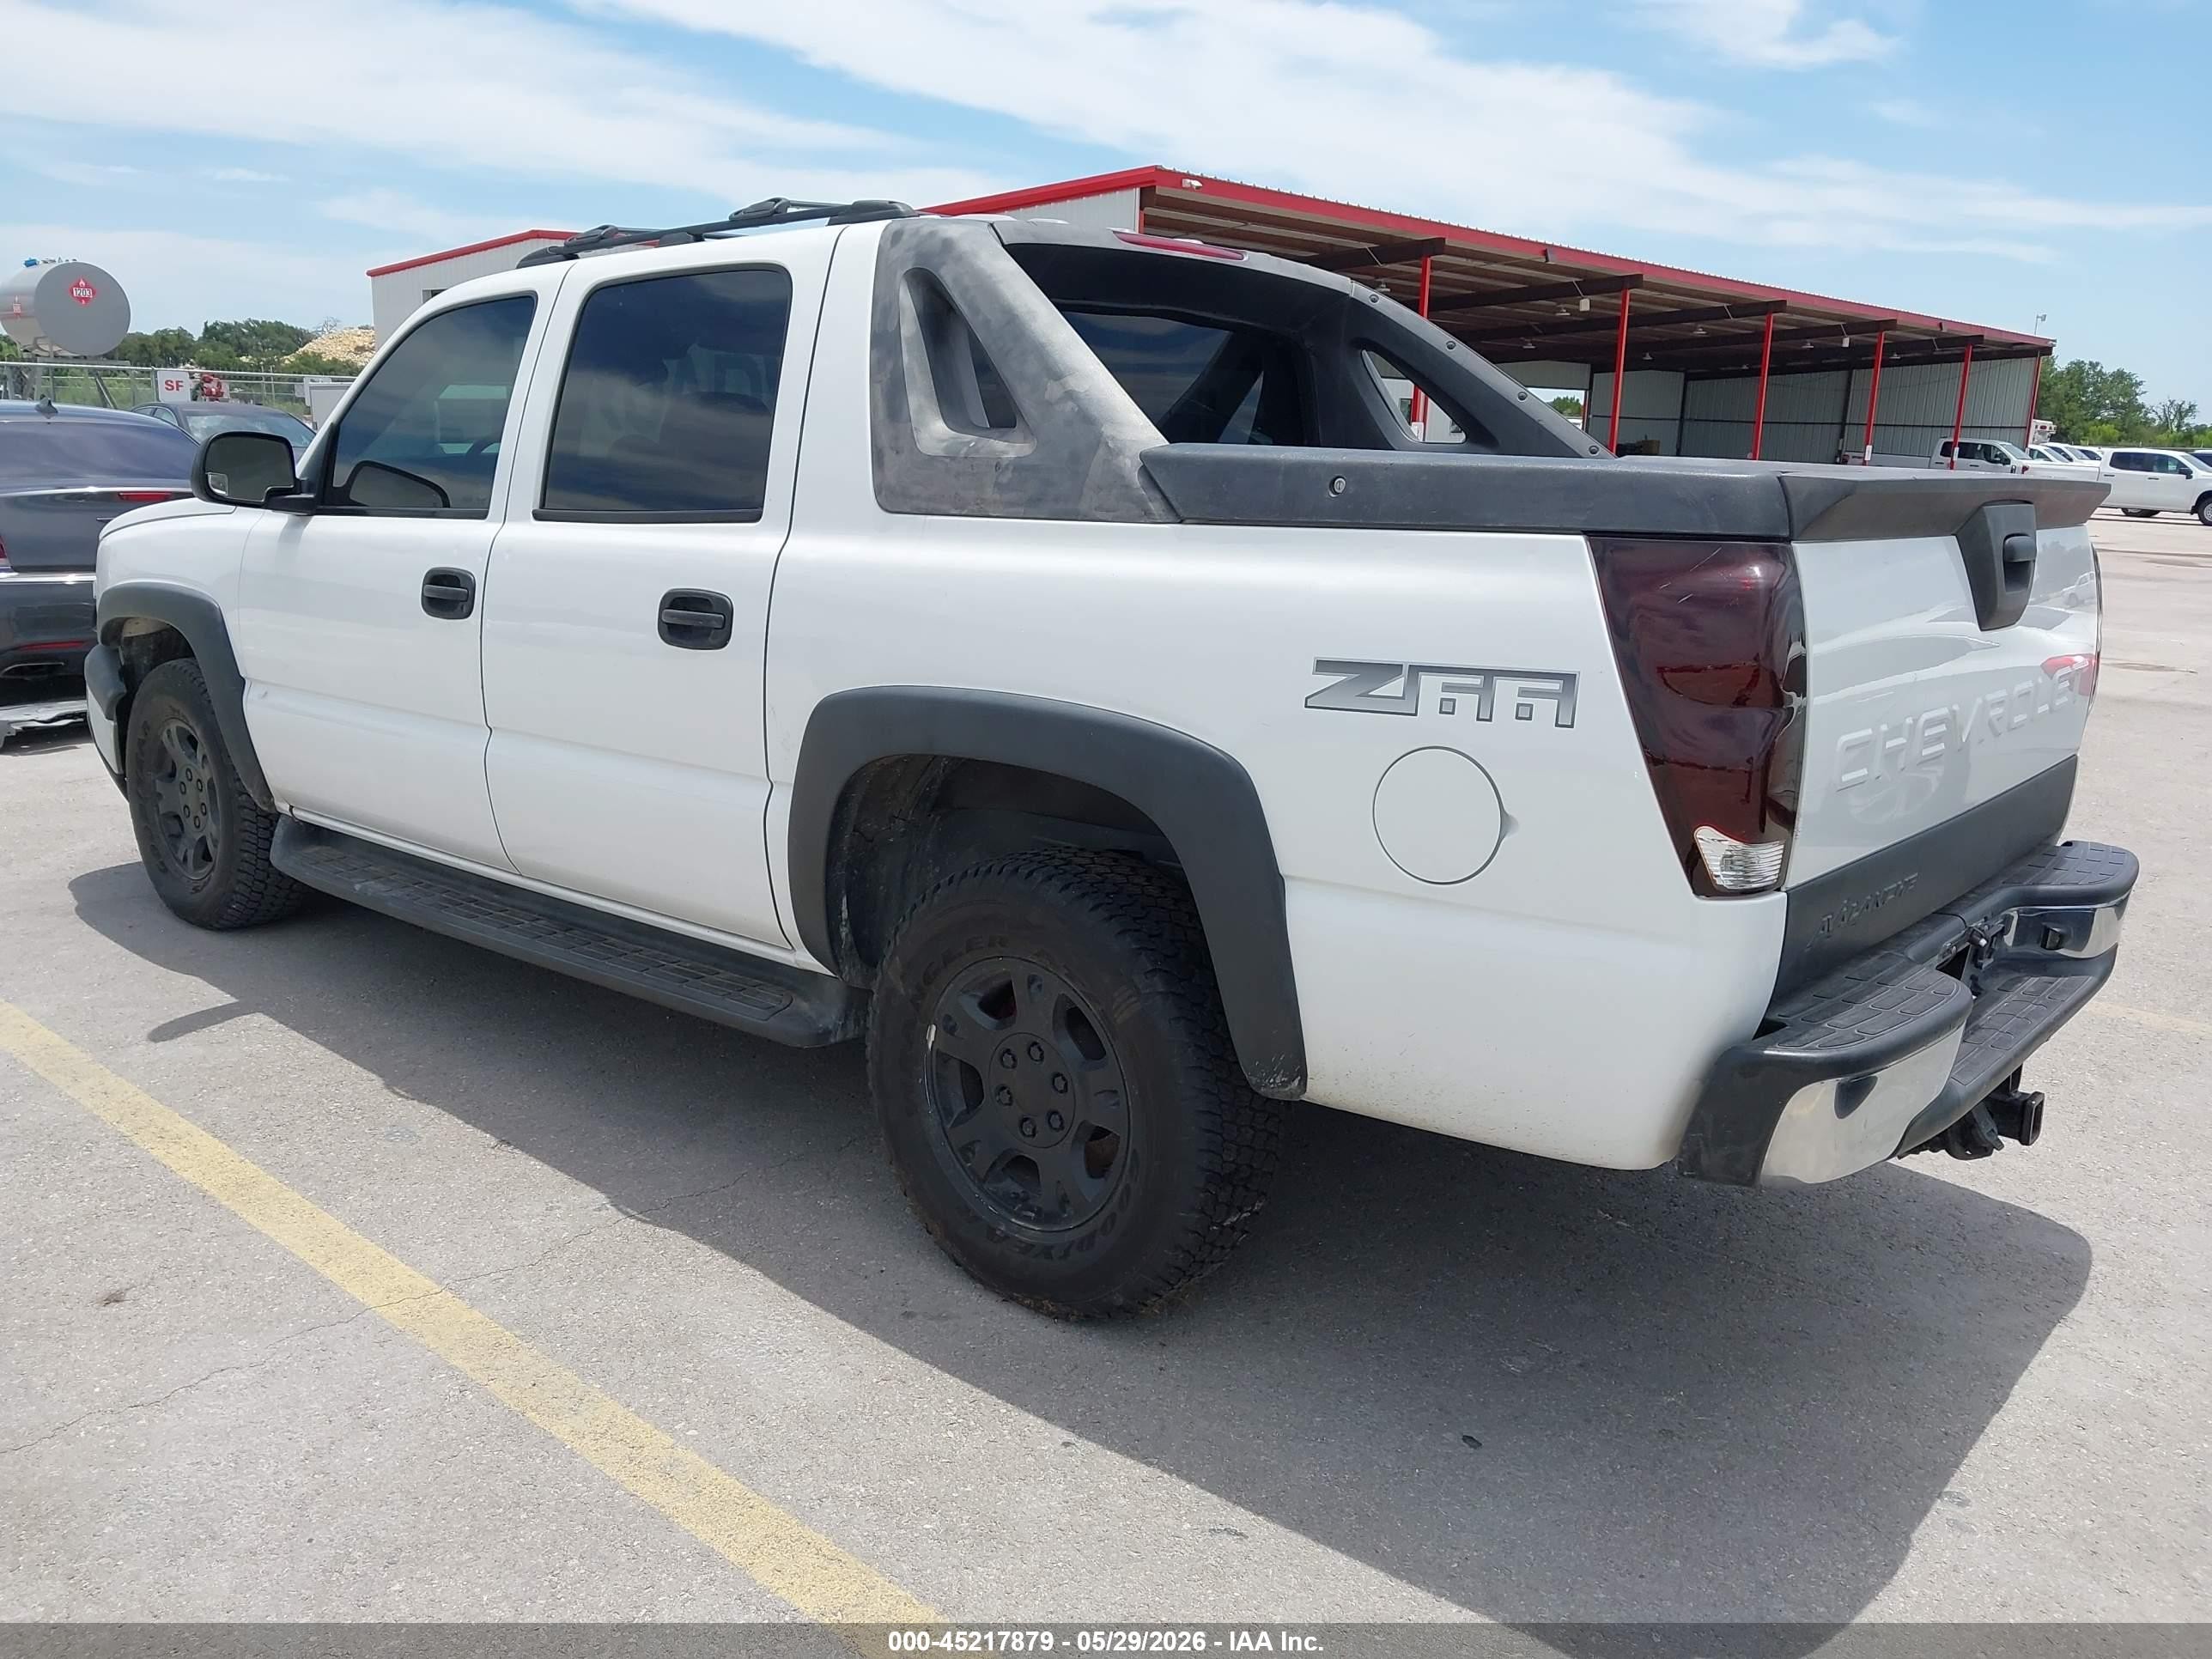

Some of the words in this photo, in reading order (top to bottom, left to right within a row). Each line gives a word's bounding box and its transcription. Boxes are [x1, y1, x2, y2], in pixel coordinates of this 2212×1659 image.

[75, 288, 92, 297] 1203
[165, 380, 184, 392] SF
[1834, 658, 2090, 792] CHEVROLET
